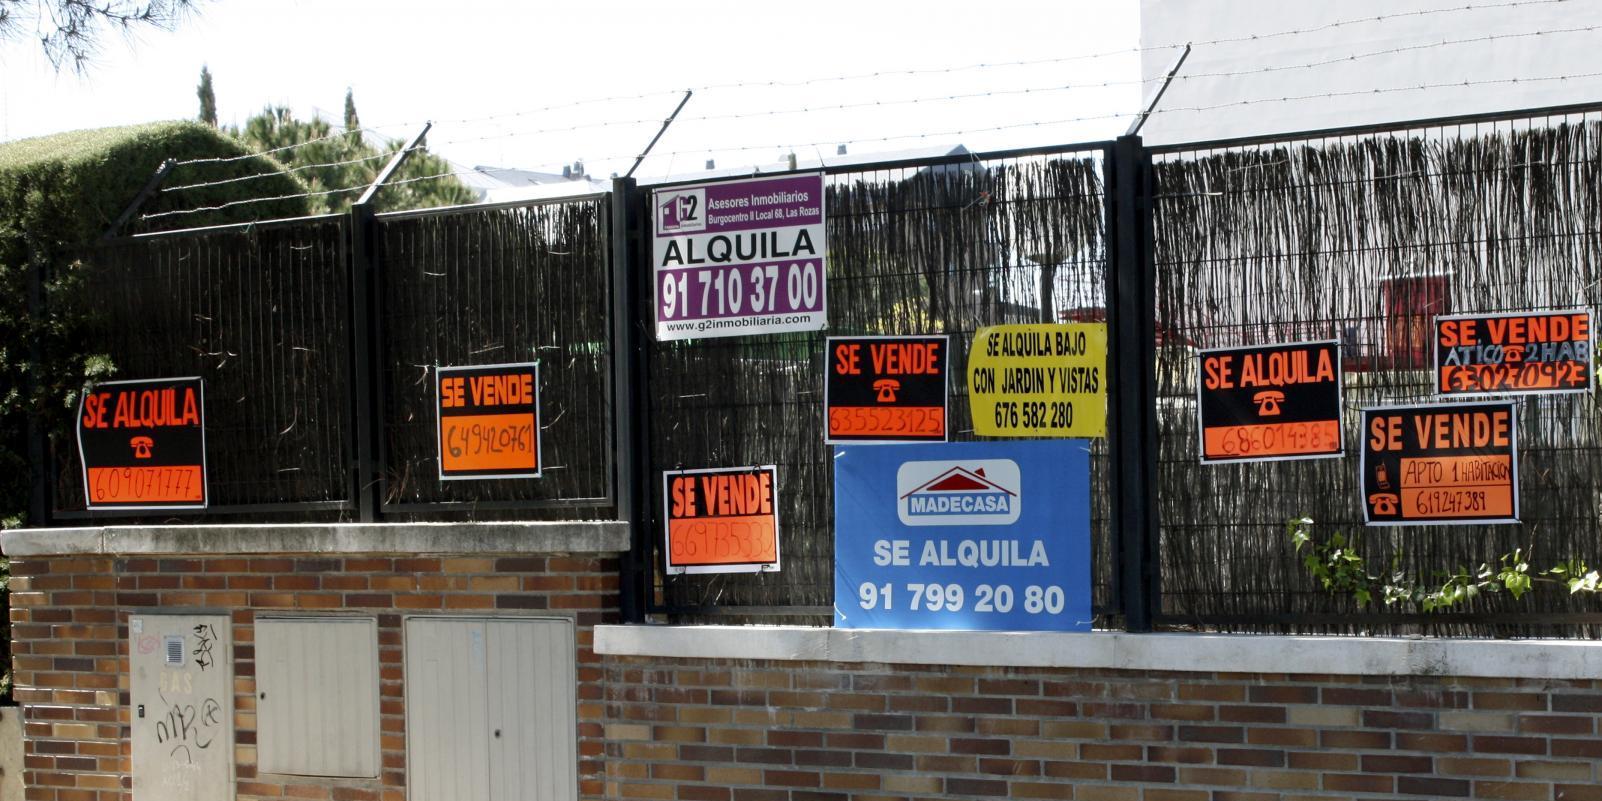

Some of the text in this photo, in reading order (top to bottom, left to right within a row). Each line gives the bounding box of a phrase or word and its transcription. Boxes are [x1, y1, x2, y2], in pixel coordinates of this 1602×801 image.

[708, 190, 809, 210] Asesores Inmobiliarios
[708, 213, 749, 226] Burgocentro
[749, 211, 755, 220] II
[755, 209, 774, 220] Local
[774, 208, 785, 220] 68,
[785, 208, 798, 218] Las
[799, 206, 819, 216] Rozas
[662, 228, 816, 267] ALQUILA
[662, 262, 817, 319] 91 710 37 00
[667, 314, 811, 331] www.g2inmobiliaria.com
[1440, 314, 1589, 347] SE VENDE
[836, 343, 939, 375] SE VENDE
[987, 331, 1086, 358] SE ALQUILA BAJO
[1524, 342, 1538, 362] 2
[1541, 340, 1589, 362] HAB
[973, 367, 1098, 394] CON JARDIN Y VISTAS
[1204, 348, 1334, 390] SE ALQUILA
[442, 373, 533, 408] SE VENDE
[83, 387, 199, 429] SE ALQUILA
[830, 408, 941, 433] 635523125
[995, 401, 1073, 429] 676 582 280
[447, 423, 532, 458] 649420761
[1370, 411, 1509, 452] SE VENDE
[96, 468, 193, 500] 609071777
[1404, 460, 1443, 484] APTO
[1451, 461, 1459, 482] 1
[672, 472, 771, 518] SE VENDE
[911, 495, 1009, 513] MADECASA
[1416, 490, 1486, 515] 619247389
[873, 539, 1049, 568] SE ALQUILA
[859, 582, 1065, 615] 91 799 20 80
